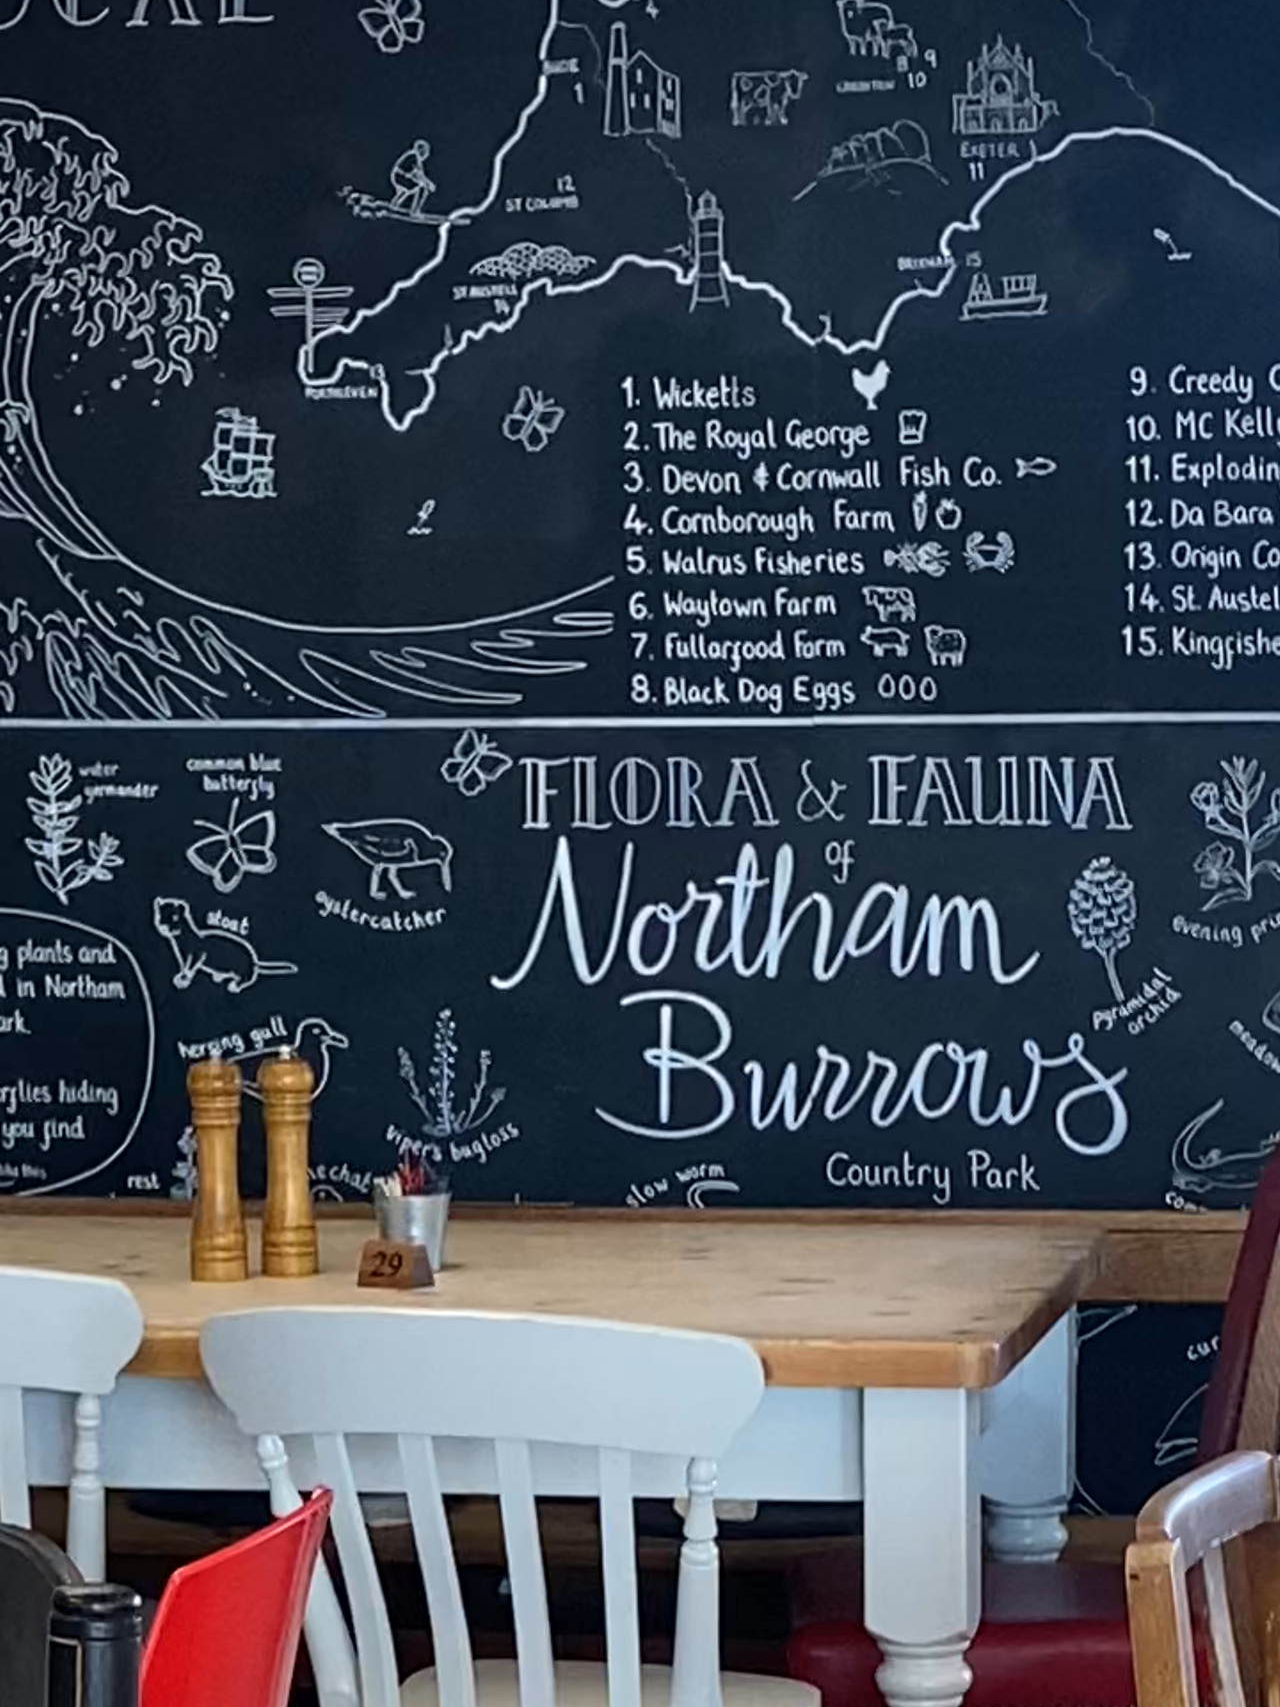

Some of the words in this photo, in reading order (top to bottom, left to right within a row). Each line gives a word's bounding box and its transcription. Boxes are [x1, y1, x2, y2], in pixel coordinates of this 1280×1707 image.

[924, 48, 937, 69] 9
[908, 71, 927, 88] 10
[959, 141, 1021, 159] EXETER
[556, 175, 575, 193] 12
[621, 376, 641, 408] 1.
[652, 374, 756, 410] Wicketts
[1130, 366, 1156, 397] 9.
[1168, 364, 1254, 404] Creedy
[623, 420, 650, 451] 2.
[651, 421, 697, 452] The
[705, 417, 777, 460] Royal
[785, 418, 871, 459] George
[1126, 414, 1161, 442] 10.
[623, 460, 652, 493] 3.
[662, 463, 742, 495] Devon
[776, 460, 881, 492] Cornwall
[899, 455, 951, 488] Fish
[962, 456, 1002, 487] Co.
[1125, 454, 1160, 483] 11.
[623, 503, 654, 536] 4.
[661, 505, 815, 542] Cornborough
[833, 498, 895, 533] Farm
[1125, 498, 1164, 528] 12.
[1170, 498, 1205, 529] Da
[1213, 499, 1274, 527] Bara
[626, 545, 653, 575] 5.
[662, 546, 748, 576] Walrus
[754, 546, 865, 576] Fisheries
[1124, 541, 1161, 571] 13.
[1170, 540, 1242, 580] Origin
[628, 590, 654, 620] 6.
[663, 589, 768, 628] Waytown
[774, 586, 837, 617] Farm
[1124, 582, 1165, 613] 14.
[630, 632, 654, 661] 7.
[1121, 625, 1163, 657] 15.
[630, 673, 658, 704] 8.
[664, 676, 731, 706] Black
[738, 677, 783, 714] Dog
[793, 675, 856, 711] Eggs
[249, 752, 283, 773] blue
[518, 755, 780, 830] FLORA
[796, 759, 847, 822] &
[867, 754, 1133, 831] FAUNA
[824, 839, 855, 884] of
[206, 908, 250, 935] stoat
[315, 891, 447, 932] oystercatcher
[489, 833, 1040, 990] Northam
[1171, 913, 1243, 948] evening
[16, 938, 74, 969] plants
[77, 942, 117, 964] and
[16, 978, 36, 999] in
[44, 973, 126, 1000] Northam
[250, 1015, 288, 1050] gull
[594, 989, 1129, 1156] Burrows
[58, 1078, 119, 1116] hiding
[1, 1122, 35, 1150] you
[39, 1115, 86, 1152] find
[449, 1122, 519, 1164] bugloss
[127, 1172, 160, 1189] rest
[625, 1174, 668, 1209] slow
[675, 1160, 726, 1184] worm
[826, 1150, 951, 1205] Country
[967, 1149, 1041, 1191] Park
[370, 1251, 403, 1278] 29
[1186, 1335, 1220, 1361] cur
